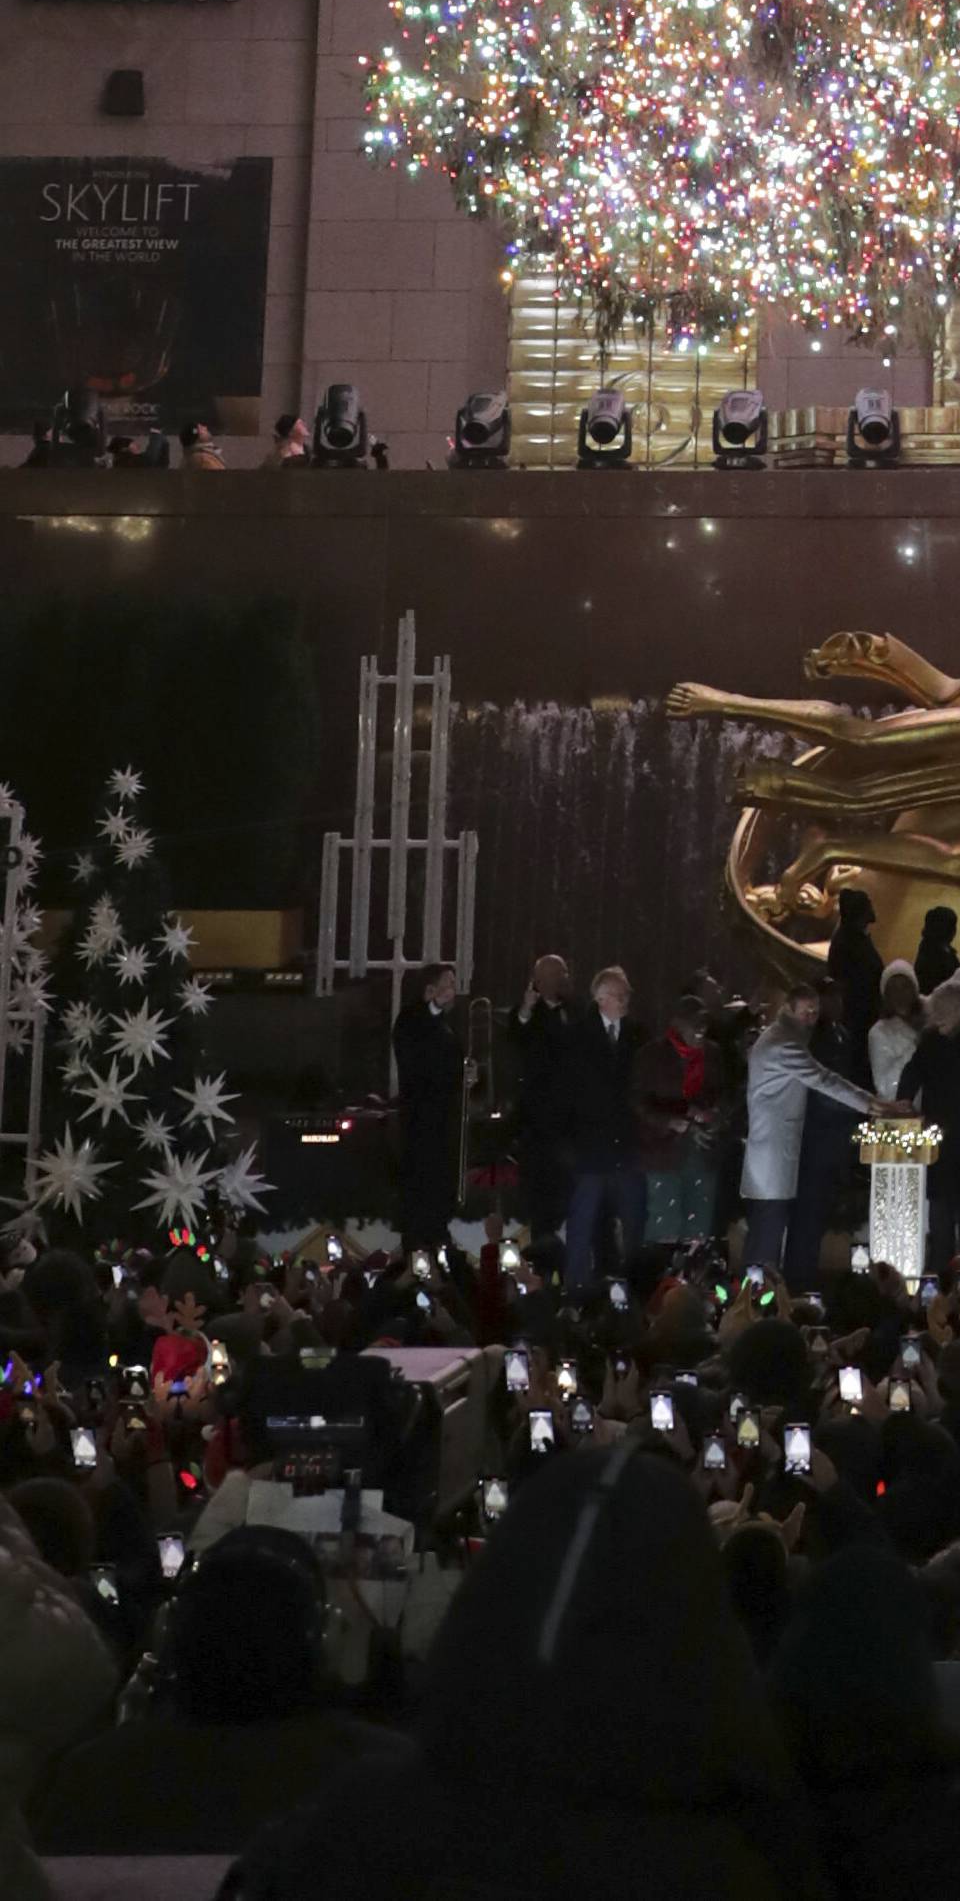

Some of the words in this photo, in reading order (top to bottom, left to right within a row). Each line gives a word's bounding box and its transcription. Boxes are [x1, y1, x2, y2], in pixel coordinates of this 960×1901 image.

[40, 183, 200, 222] SKYLIFT
[75, 226, 137, 237] WELCOME
[142, 226, 159, 237] TO
[55, 238, 79, 250] THE
[81, 238, 143, 250] GREATEST
[145, 238, 179, 250] VIEW
[71, 251, 85, 262] IN
[88, 251, 112, 262] THE
[114, 251, 161, 262] WORLD
